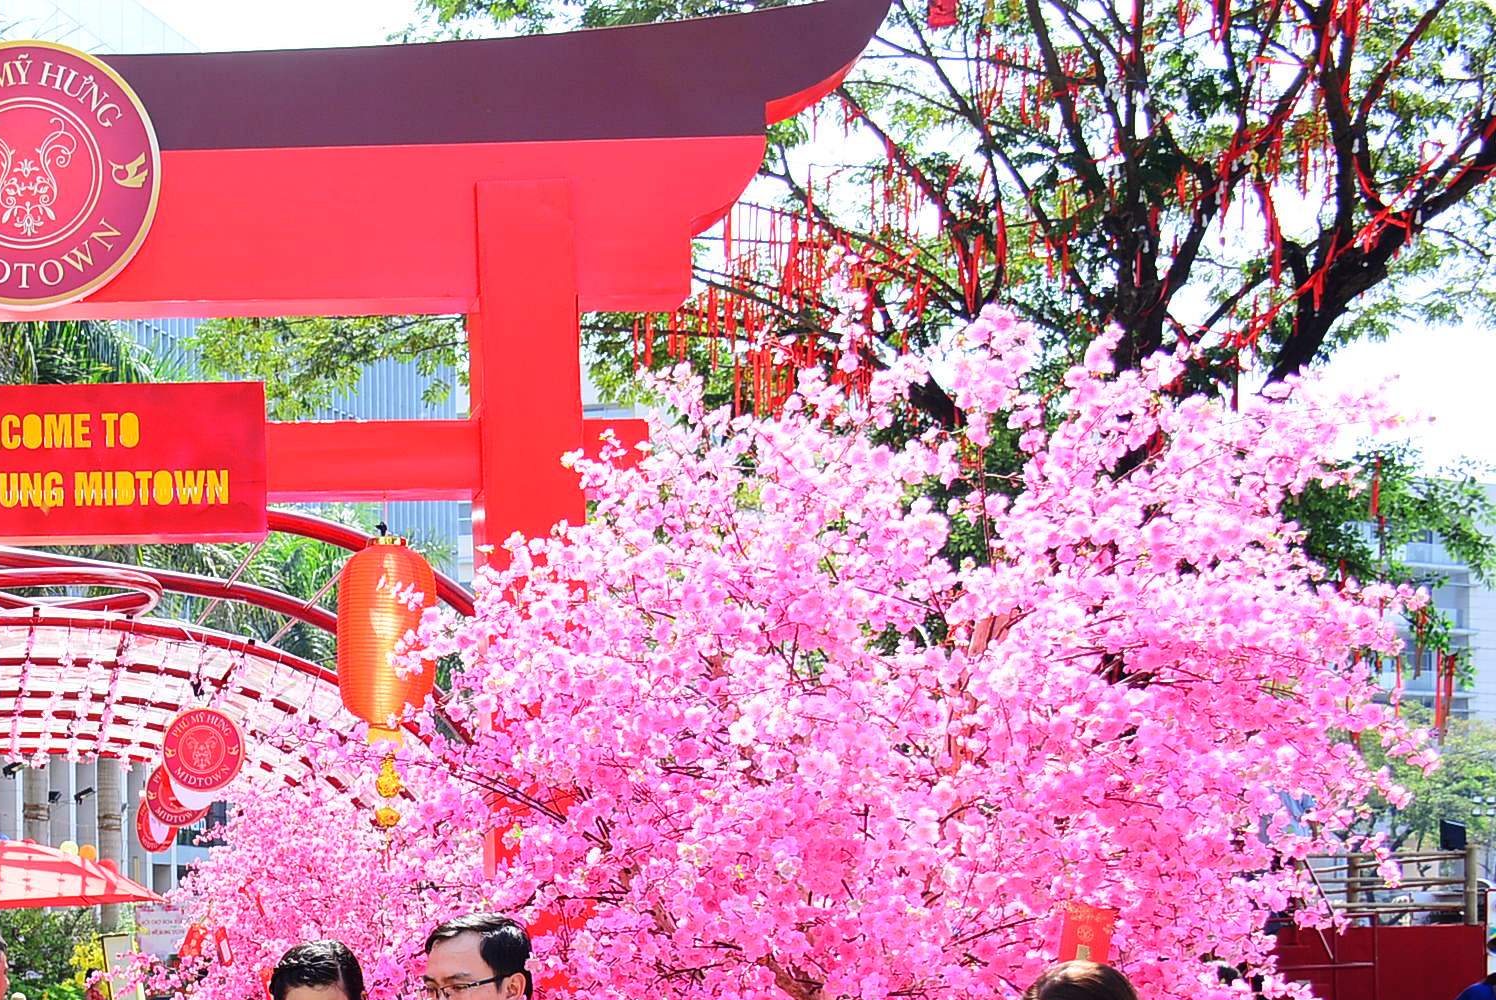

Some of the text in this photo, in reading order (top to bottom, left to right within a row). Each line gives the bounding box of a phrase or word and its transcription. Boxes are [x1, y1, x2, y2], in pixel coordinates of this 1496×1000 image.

[39, 60, 123, 130] HƯNG
[101, 411, 140, 448] TO
[74, 469, 230, 506] MIDTOWN
[152, 771, 162, 784] PH
[174, 765, 231, 787] MIDTOWN
[154, 807, 193, 823] MIDTOW
